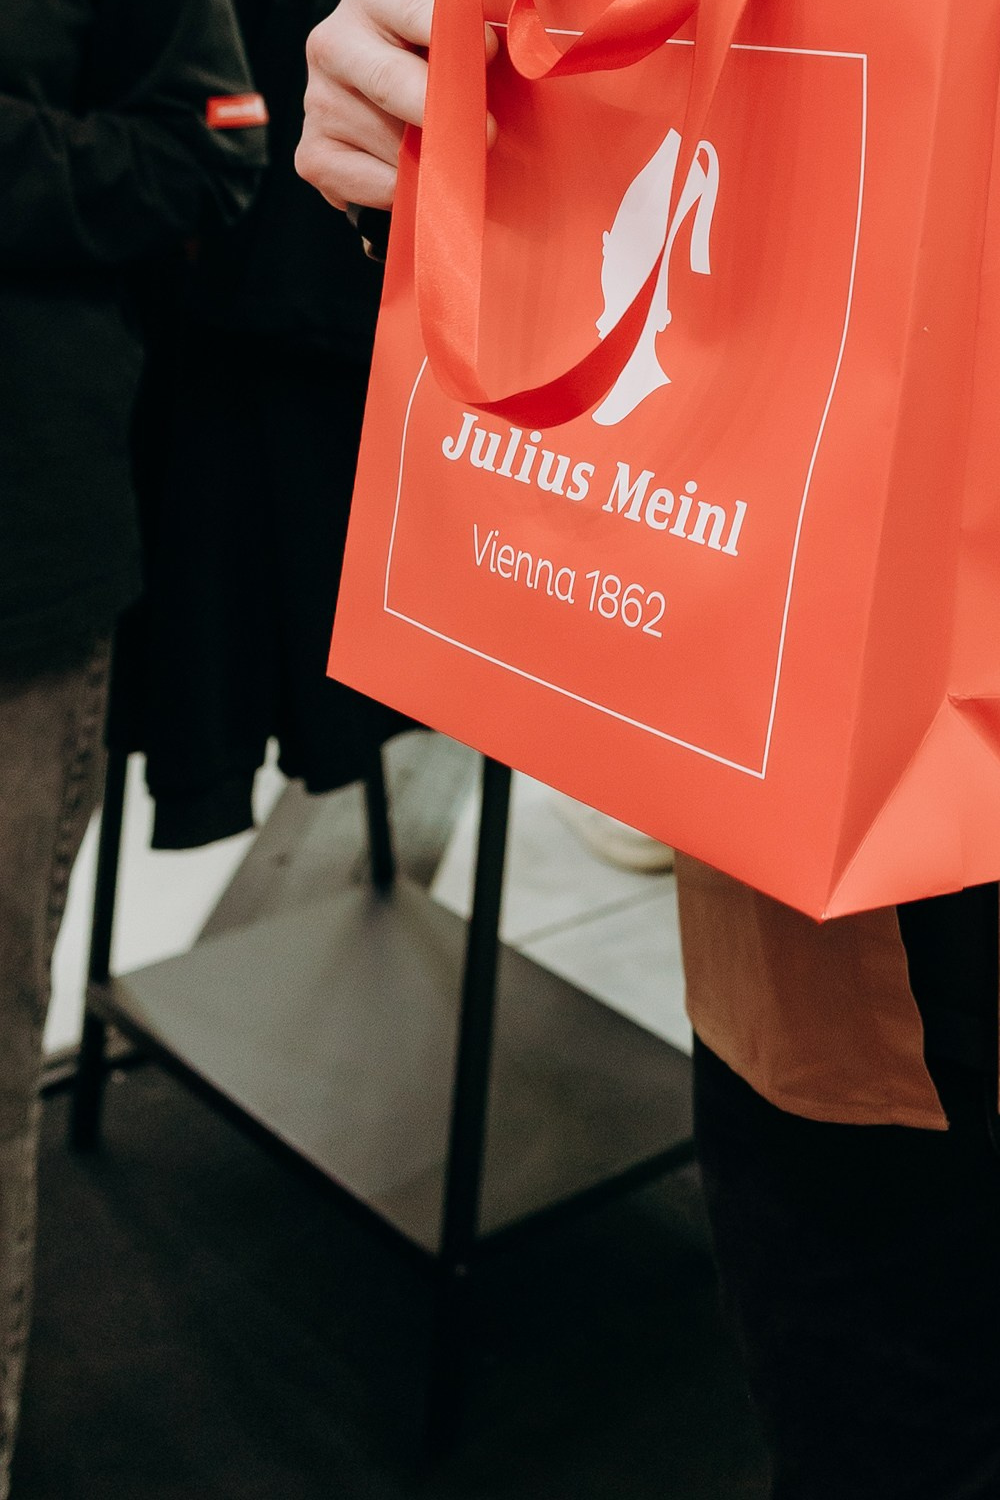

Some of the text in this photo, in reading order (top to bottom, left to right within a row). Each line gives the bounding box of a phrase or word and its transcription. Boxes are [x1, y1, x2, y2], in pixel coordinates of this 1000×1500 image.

[442, 411, 748, 557] Julius Meinl
[473, 523, 667, 638] Vienna 1862
